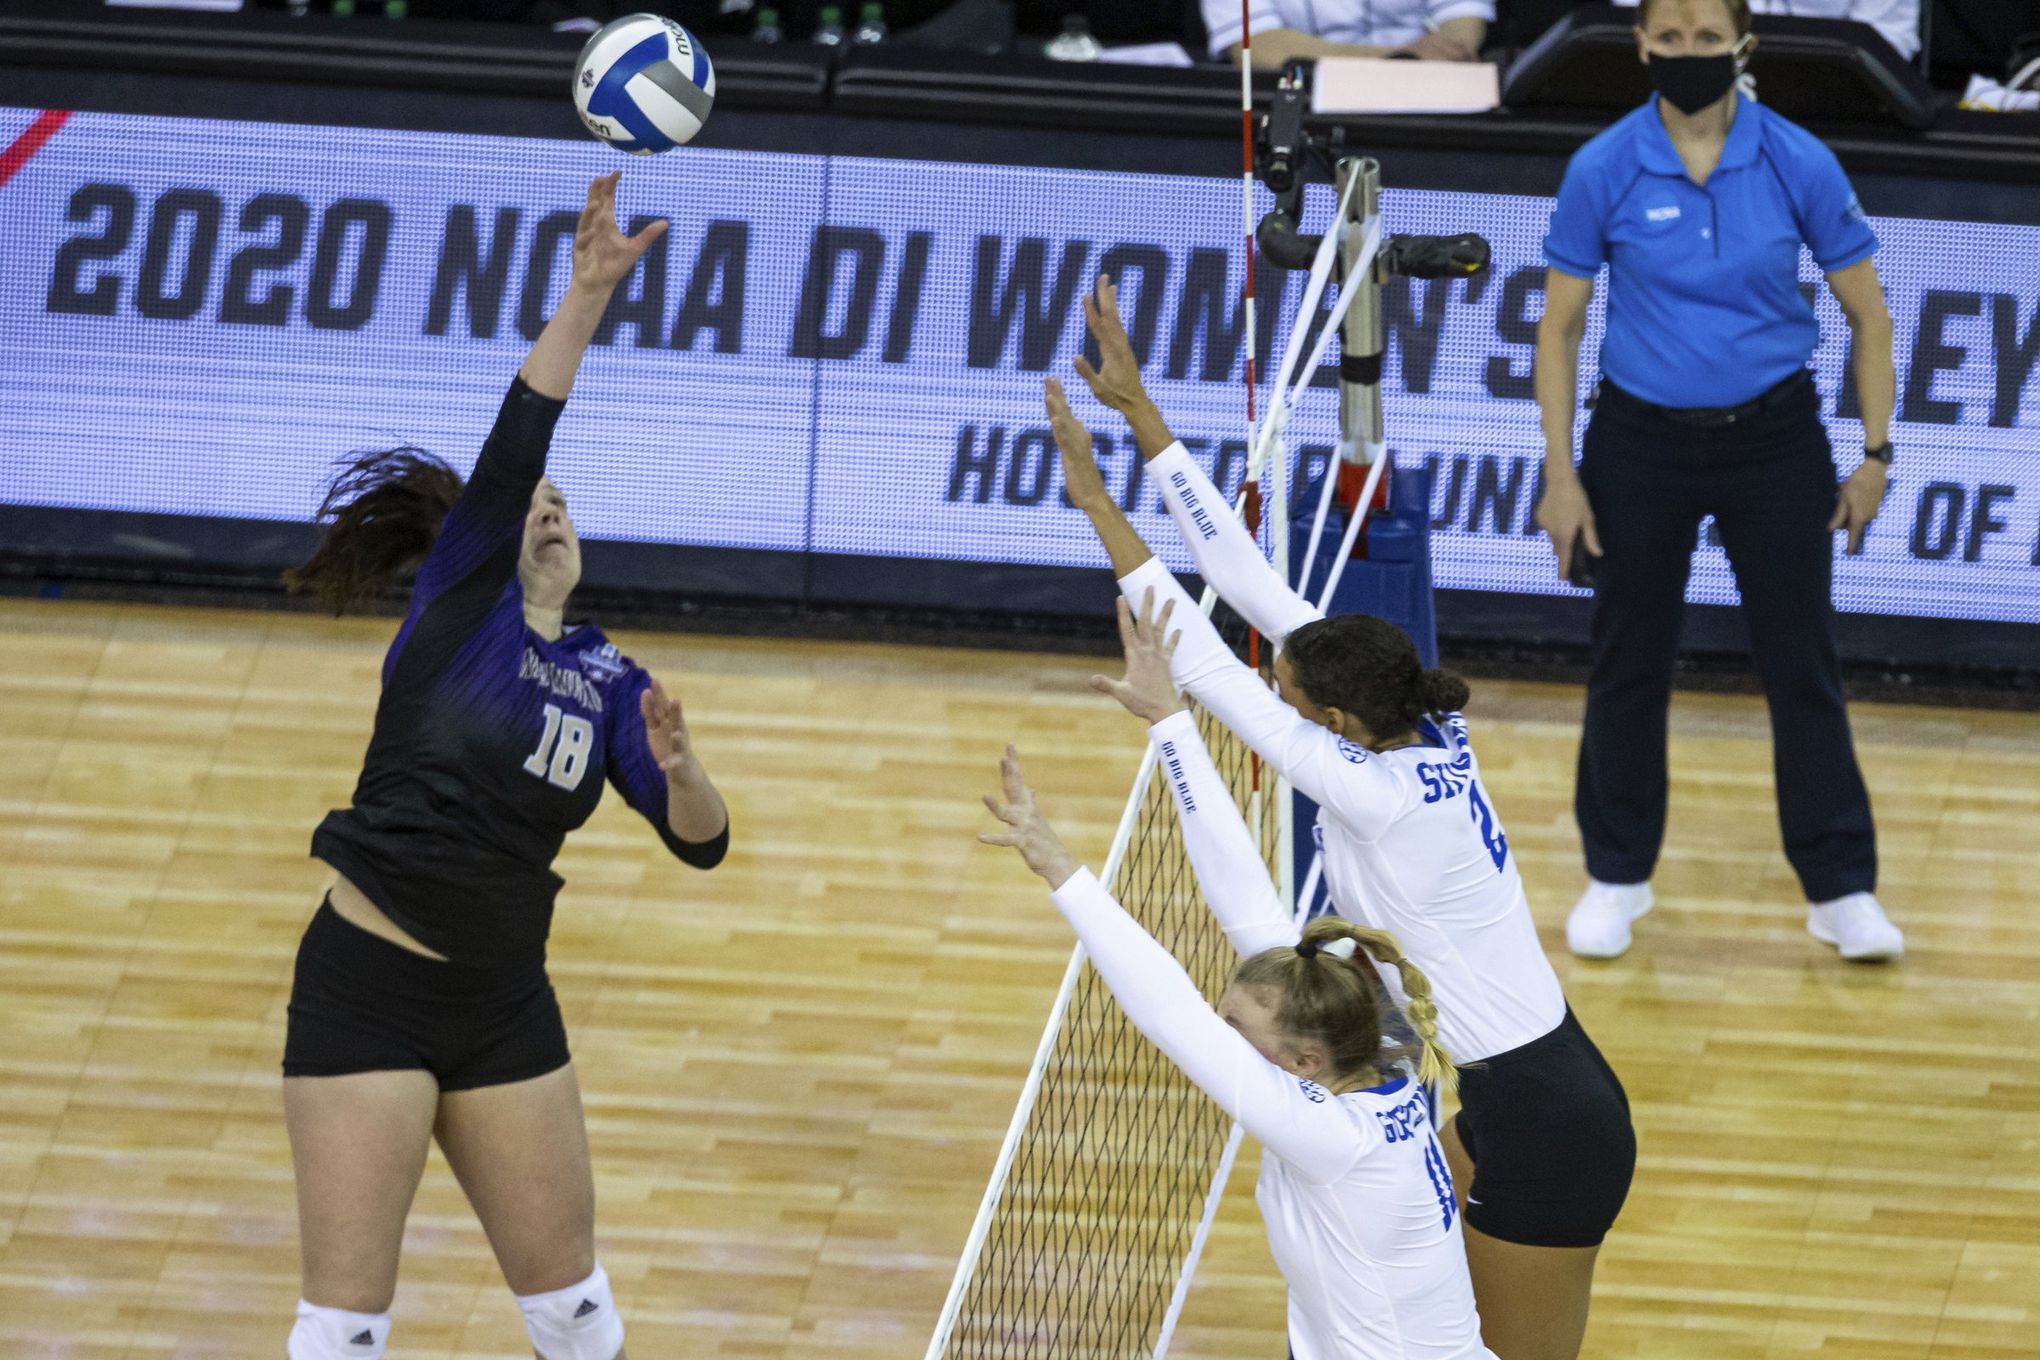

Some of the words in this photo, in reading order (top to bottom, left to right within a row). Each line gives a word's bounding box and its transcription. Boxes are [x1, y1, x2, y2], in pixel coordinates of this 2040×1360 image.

[46, 181, 395, 331] 2020
[421, 203, 750, 355] NCAA
[788, 224, 933, 364] DI
[1170, 471, 1187, 489] GO
[1180, 486, 1200, 509] BIG
[1191, 506, 1218, 541] BLUE
[1909, 480, 2017, 563] OF
[522, 703, 594, 792] 18
[1468, 778, 1508, 874] 2
